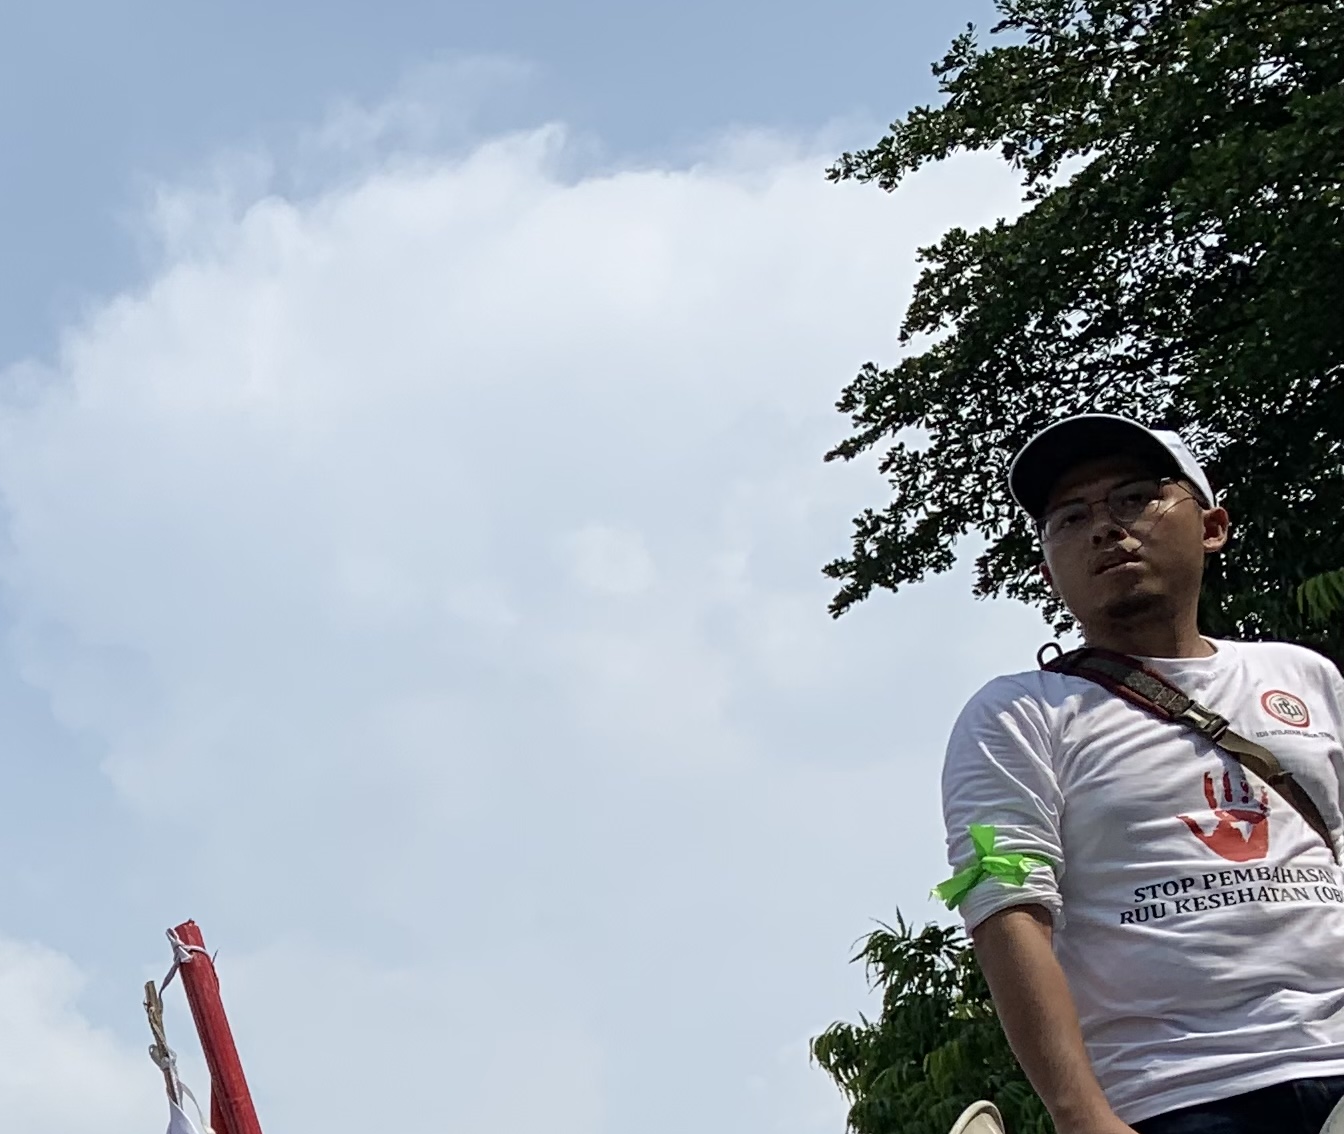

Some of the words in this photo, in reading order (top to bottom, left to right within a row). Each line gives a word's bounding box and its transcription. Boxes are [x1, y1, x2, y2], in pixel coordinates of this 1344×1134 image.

[1120, 903, 1165, 925] RUU
[1175, 886, 1310, 915] KESEHATAN
[1134, 877, 1195, 903] STOP
